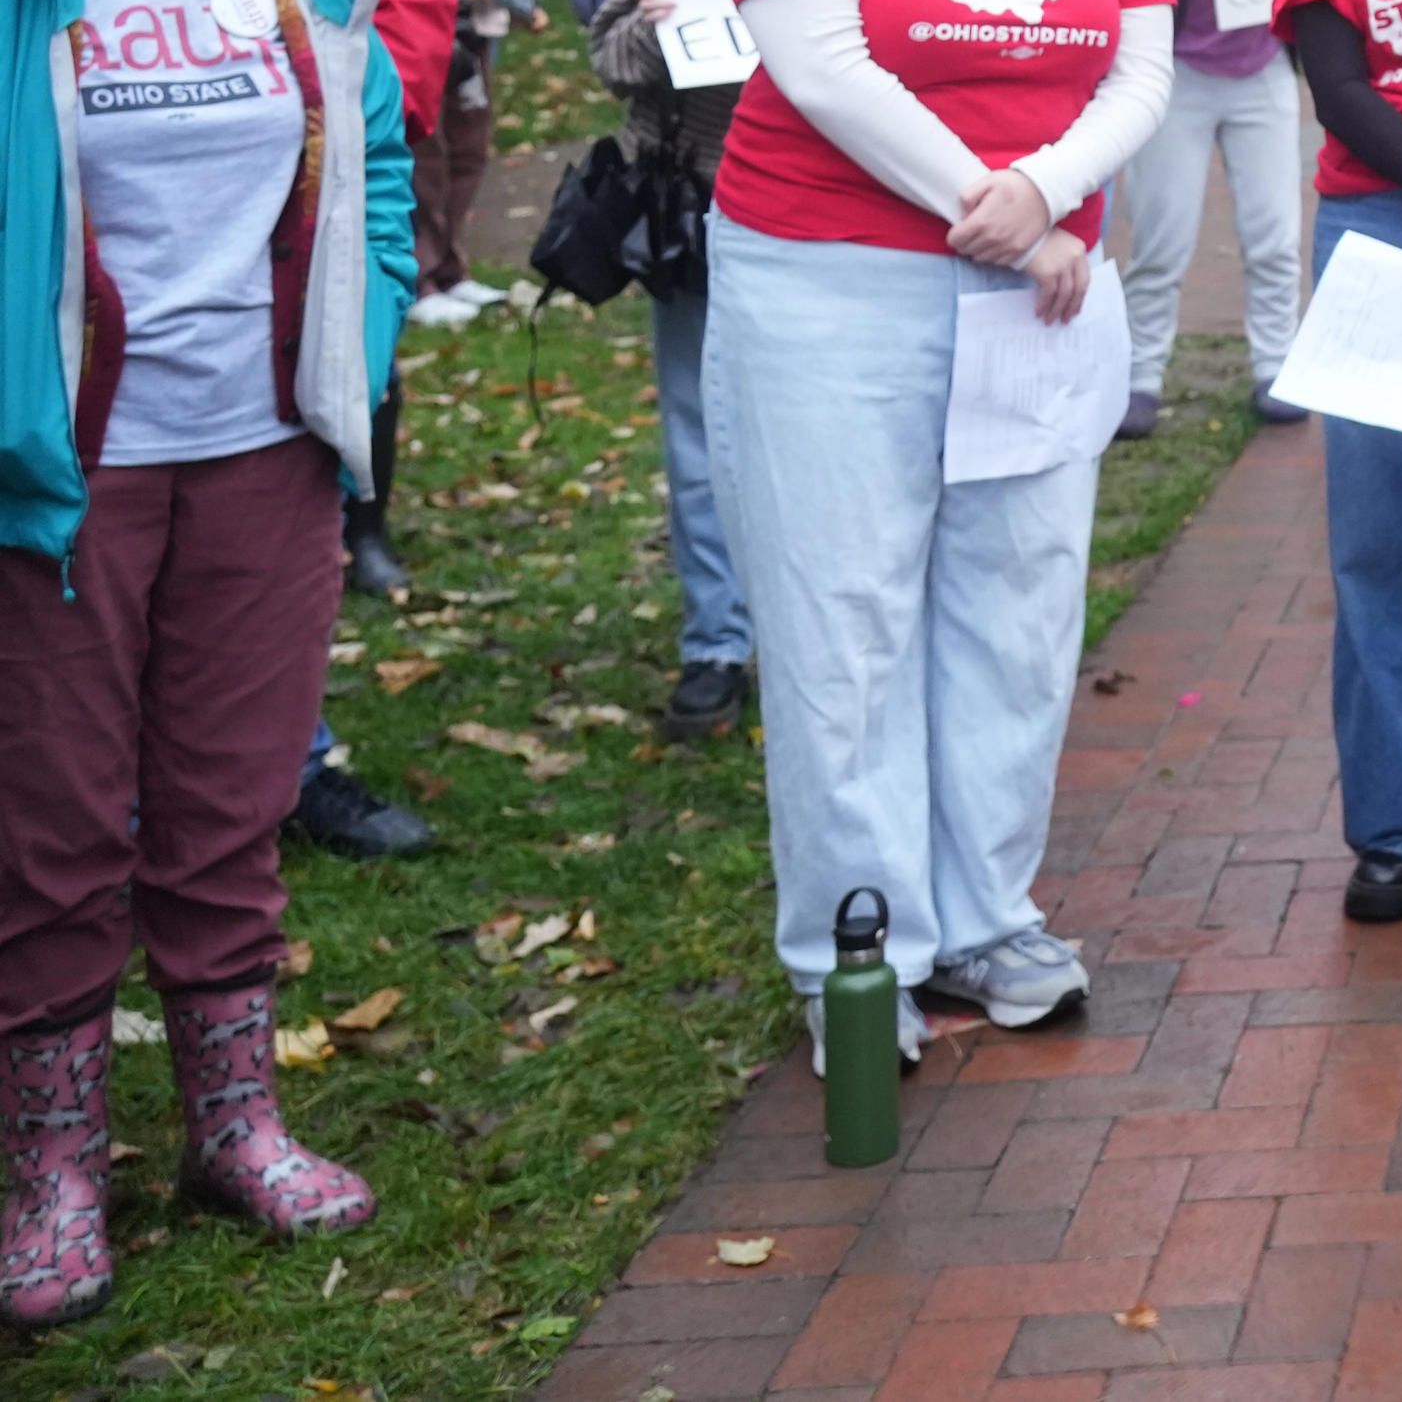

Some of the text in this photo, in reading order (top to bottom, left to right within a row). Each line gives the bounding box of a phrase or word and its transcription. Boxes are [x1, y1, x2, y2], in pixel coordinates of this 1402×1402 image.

[908, 21, 1110, 48] @OHIOSTUDENTS
[91, 75, 251, 109] OHIO STATE
